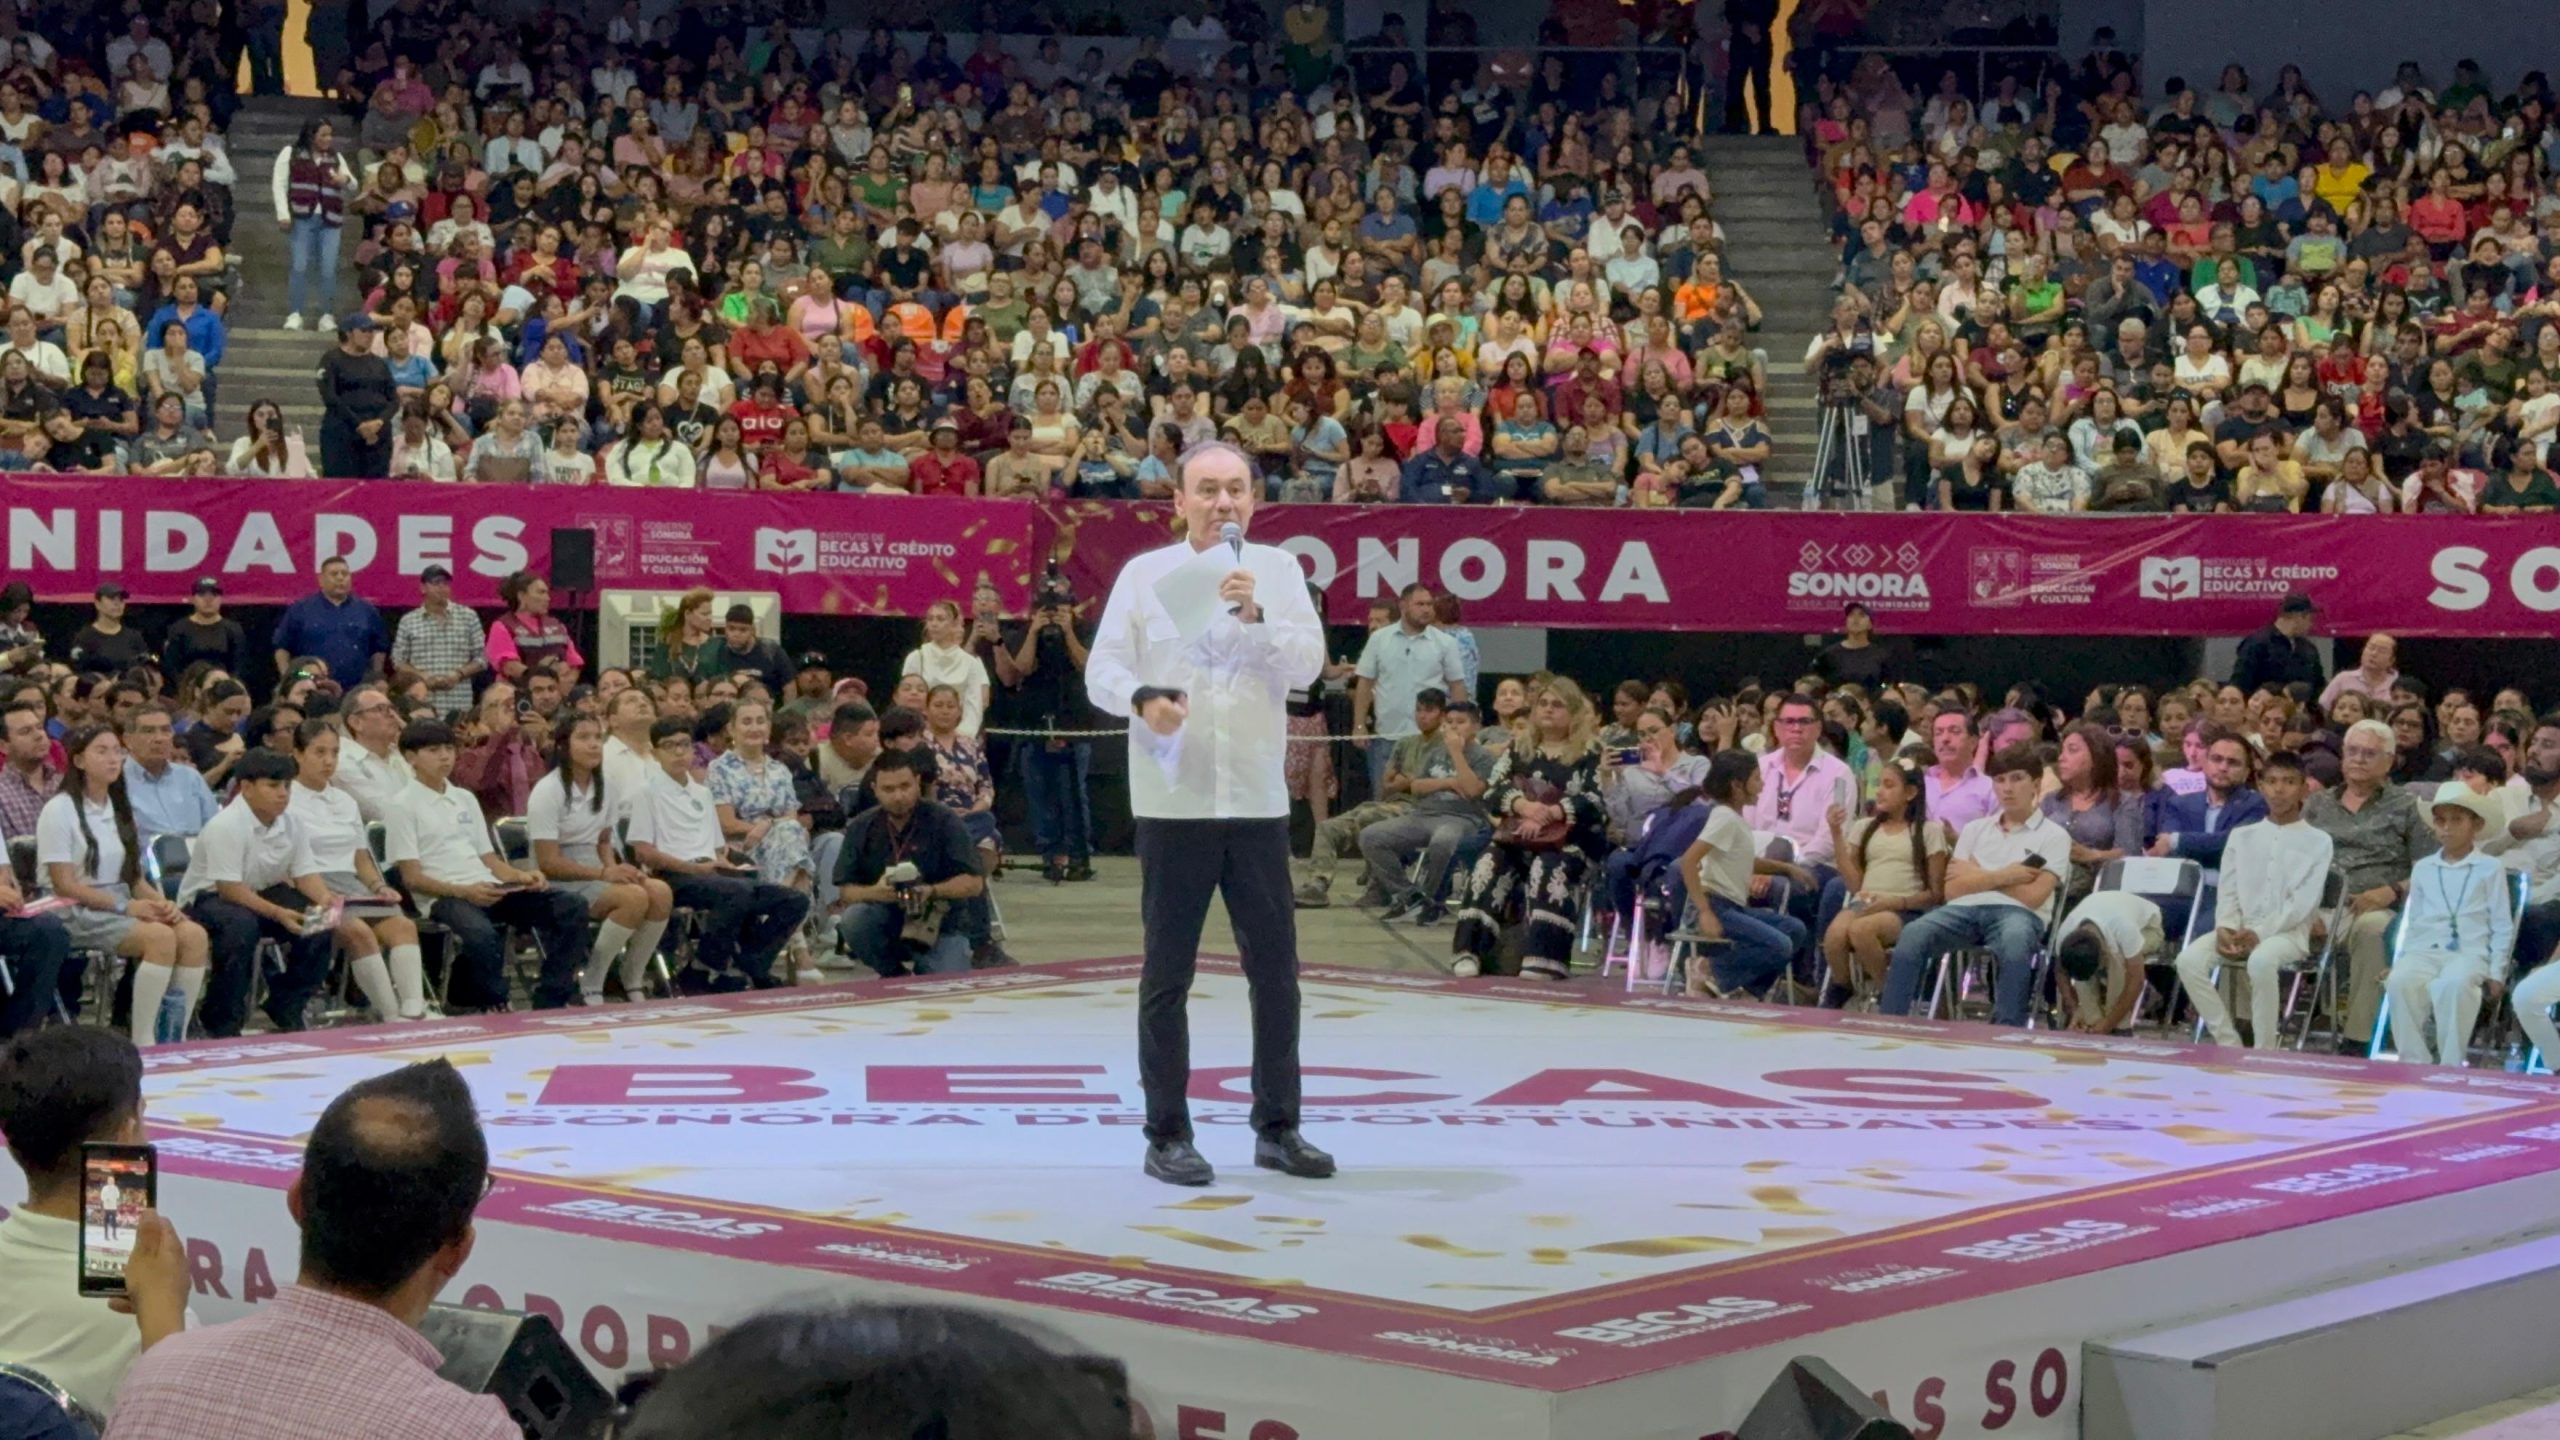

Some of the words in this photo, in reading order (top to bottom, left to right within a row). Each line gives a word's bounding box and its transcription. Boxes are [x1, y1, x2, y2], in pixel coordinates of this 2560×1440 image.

[8, 508, 529, 578] NIDADES
[820, 541, 870, 554] BECAS
[874, 542, 884, 554] Y
[887, 539, 956, 557] CRÉDITO
[820, 554, 908, 569] EDUCATIVO
[1278, 535, 1671, 603] ONORA
[1787, 571, 1931, 597] SONORA
[2203, 566, 2253, 579] BECAS
[2256, 566, 2267, 579] Y
[2271, 563, 2339, 579] CRÉDITO
[2203, 580, 2291, 593] EDUCATIVO
[535, 1063, 2053, 1111] BECAS
[490, 1114, 985, 1127] SONORA
[547, 1198, 783, 1235] BECAS
[1941, 1218, 2128, 1260] BECAS
[1041, 1271, 1319, 1319] BECAS
[1552, 1296, 1778, 1343] BECAS
